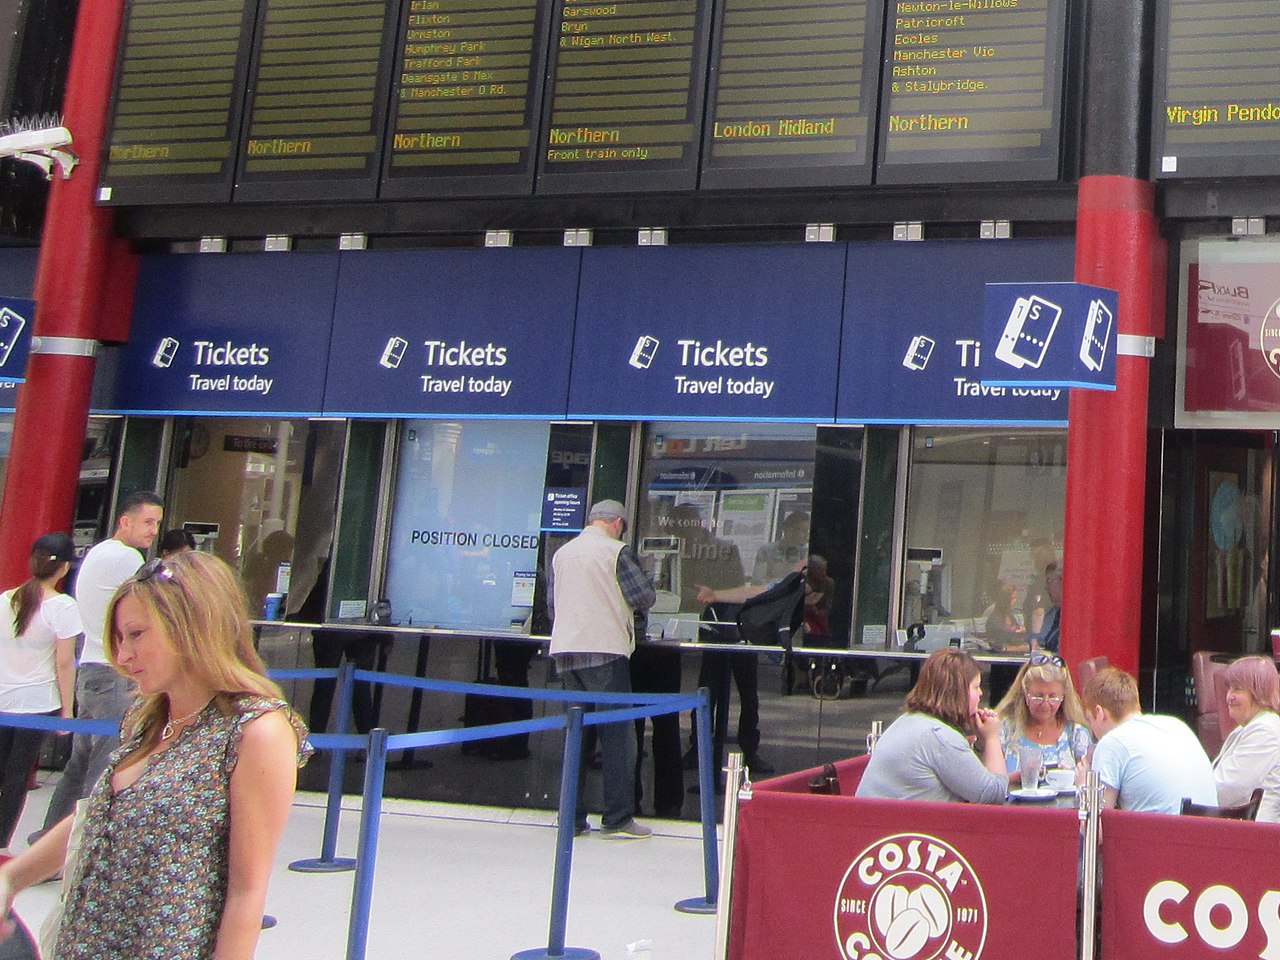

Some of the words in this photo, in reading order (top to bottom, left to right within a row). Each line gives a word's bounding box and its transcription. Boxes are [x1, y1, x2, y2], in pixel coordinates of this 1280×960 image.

[889, 115, 968, 132] Northern
[1167, 106, 1219, 124] Virgin
[550, 129, 619, 143] Northern
[713, 122, 771, 138] London
[778, 118, 834, 135] Midland
[248, 139, 311, 154] Northern
[547, 149, 580, 160] Front
[586, 148, 616, 159] train
[622, 147, 649, 160] only
[1265, 329, 1280, 337] SINCE
[194, 342, 270, 367] Tickets
[424, 342, 508, 368] Tickets
[677, 340, 768, 368] Tickets
[190, 374, 229, 392] Travel
[233, 374, 274, 394] today
[420, 376, 465, 394] Travel
[469, 376, 512, 396] today
[674, 377, 722, 395] Travel
[726, 377, 774, 399] today
[411, 530, 478, 548] POSITION
[482, 532, 539, 550] CLOSED
[858, 840, 963, 893] COSTA
[841, 899, 866, 914] SINCE
[957, 908, 978, 922] 1971
